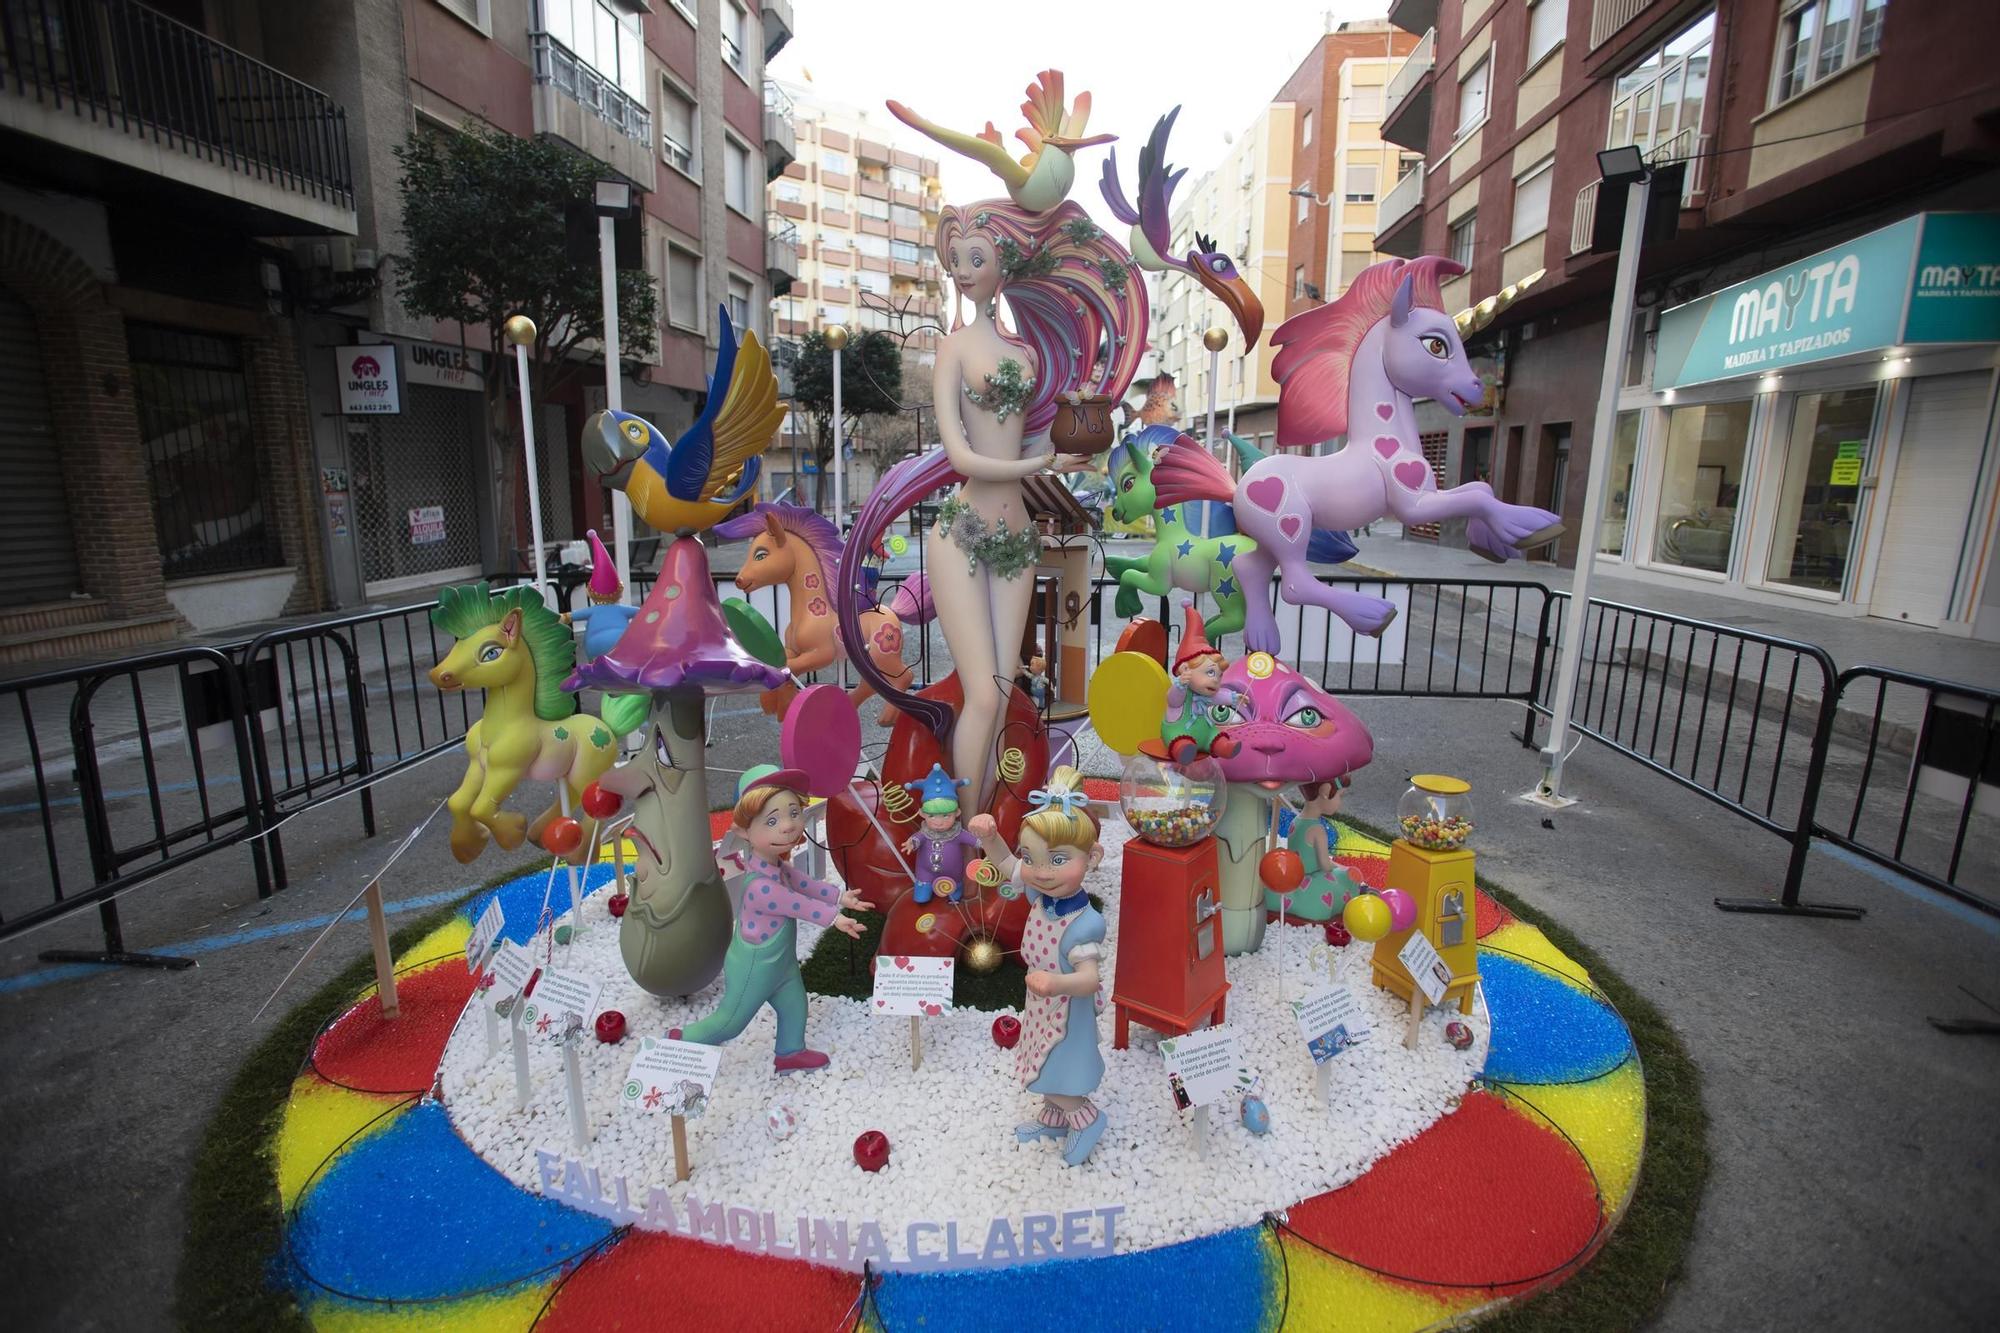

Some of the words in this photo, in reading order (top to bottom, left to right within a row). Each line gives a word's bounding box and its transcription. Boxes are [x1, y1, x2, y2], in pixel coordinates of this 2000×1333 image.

[1920, 265, 2000, 287] MAYTA
[1729, 254, 1860, 345] MAYTA
[1723, 346, 1766, 369] MADERA
[1769, 343, 1778, 359] Y
[1779, 327, 1851, 357] TAPIZADOS
[348, 380, 389, 391] UNGLES
[1067, 407, 1106, 437] Mel
[1214, 1056, 1231, 1064] ranura
[536, 1147, 679, 1228] FALLA
[686, 1191, 890, 1264] MOLINA
[906, 1204, 1126, 1265] CLARET
